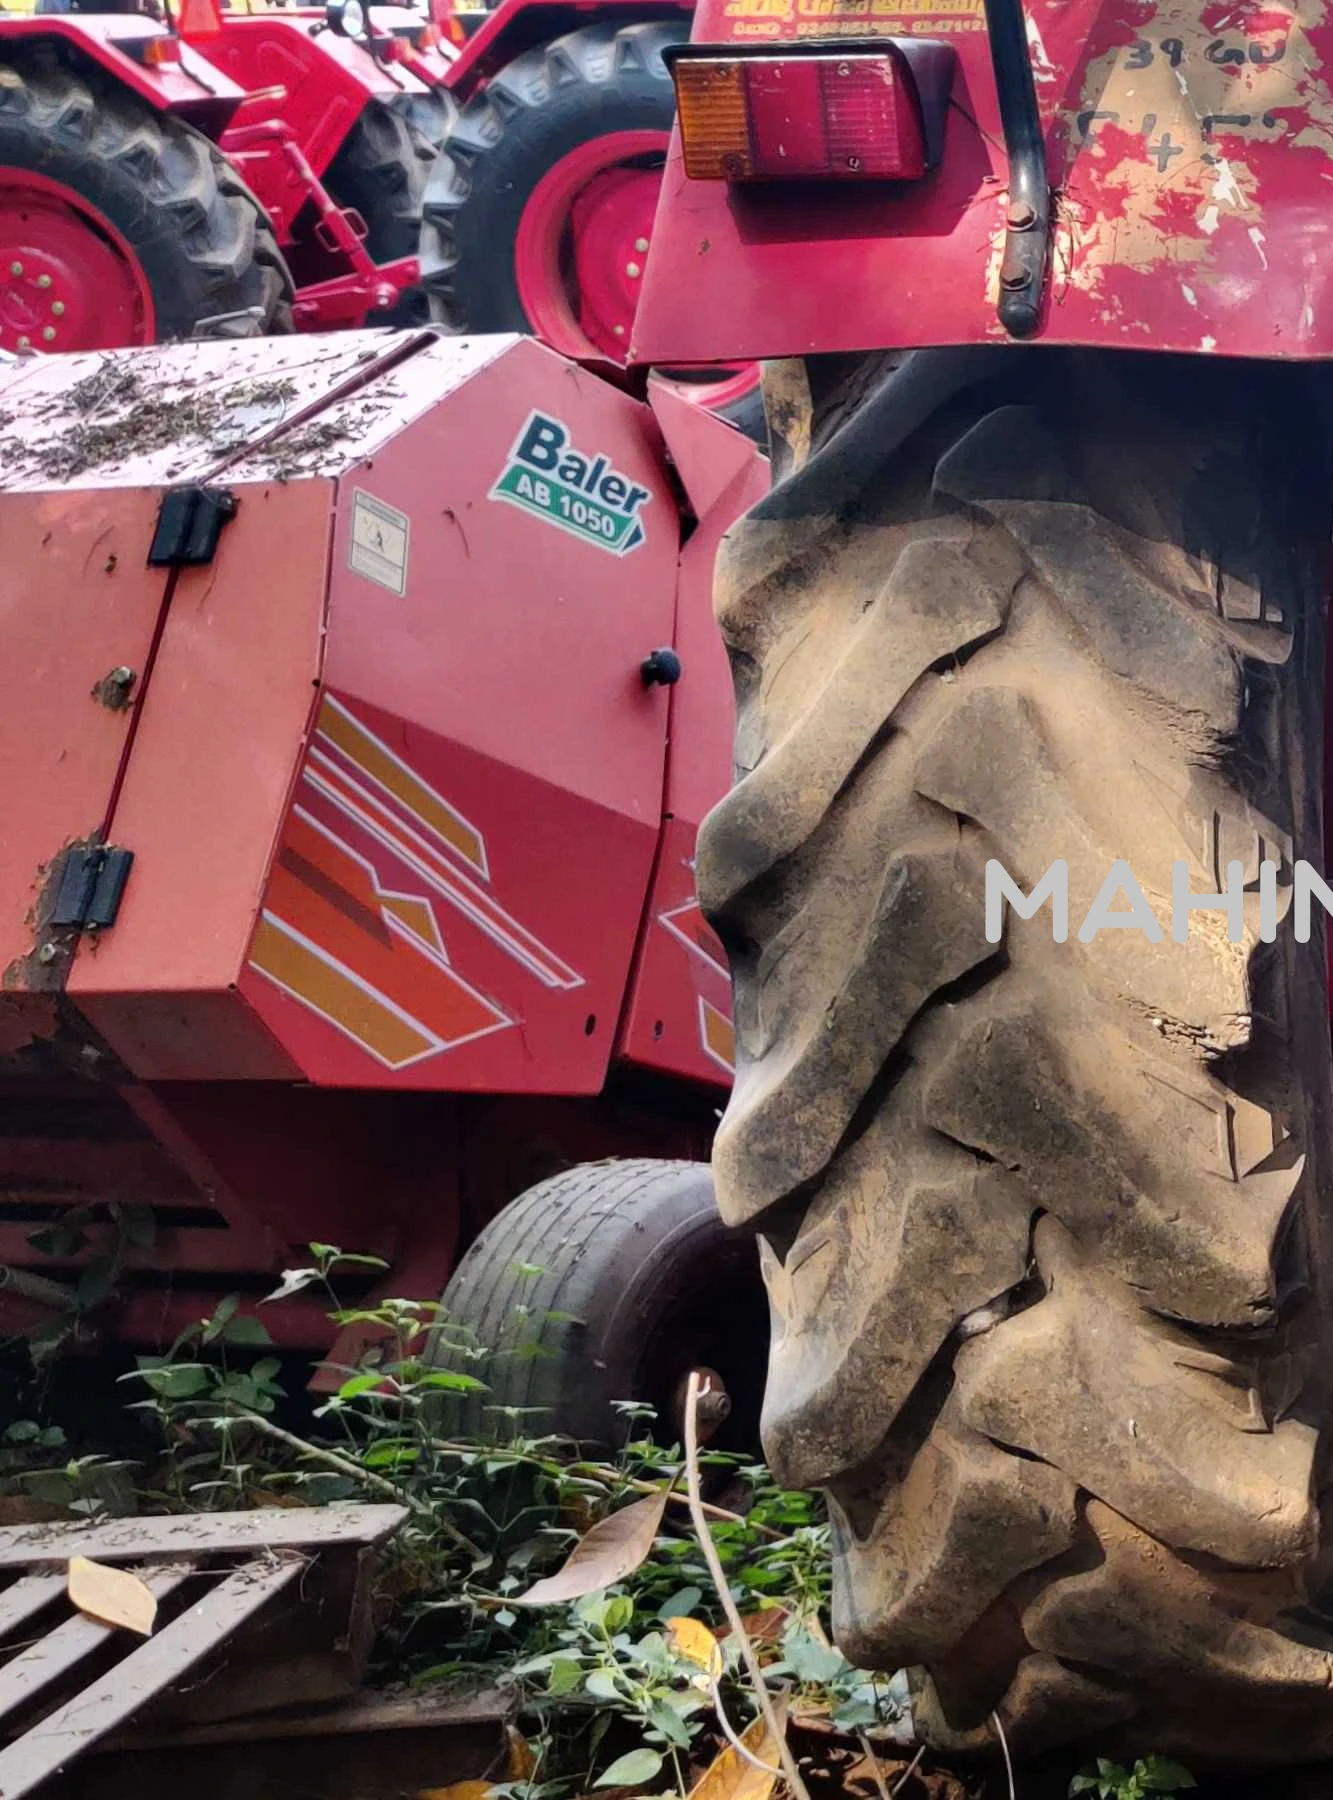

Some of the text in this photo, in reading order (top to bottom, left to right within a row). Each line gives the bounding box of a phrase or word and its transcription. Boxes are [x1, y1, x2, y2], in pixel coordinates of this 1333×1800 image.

[515, 473, 616, 538] AB 1050
[516, 415, 648, 514] Baler
